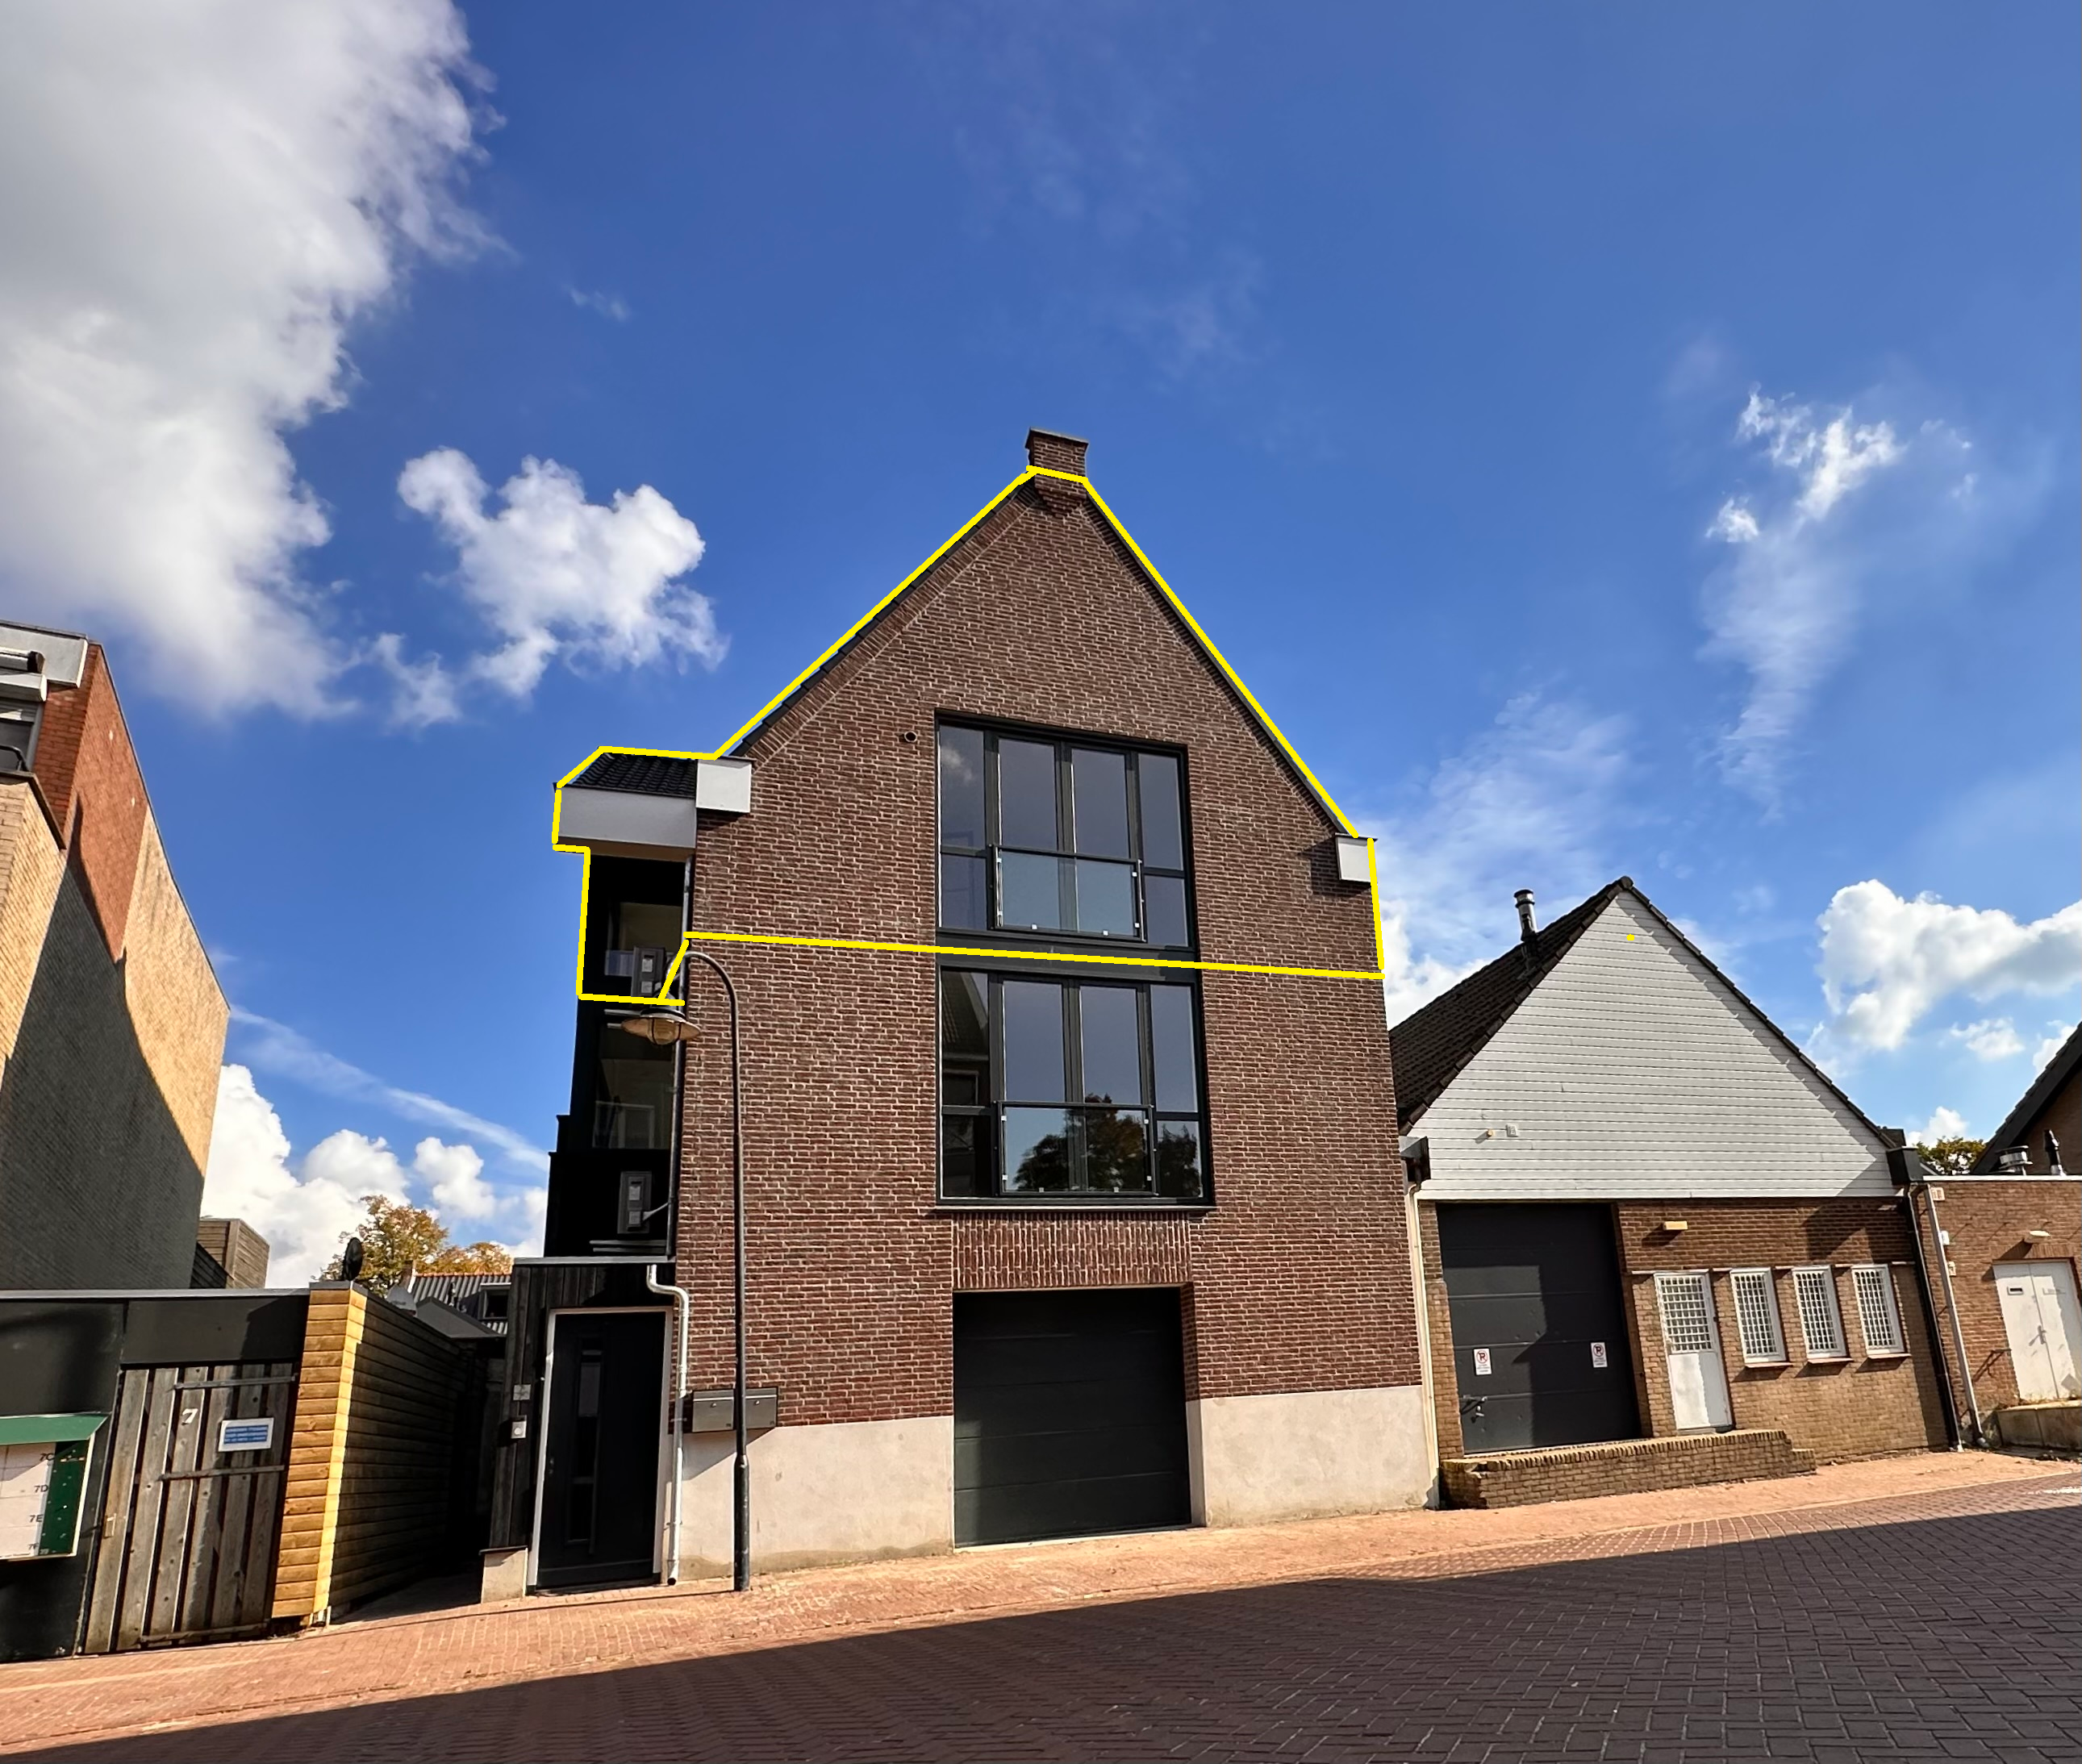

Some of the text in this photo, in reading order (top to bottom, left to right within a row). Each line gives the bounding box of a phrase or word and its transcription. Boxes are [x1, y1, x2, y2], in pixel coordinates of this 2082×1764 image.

[181, 1408, 198, 1424] 7
[40, 1453, 55, 1462] 7C
[34, 1484, 48, 1493] 7D
[29, 1514, 44, 1523] 7E
